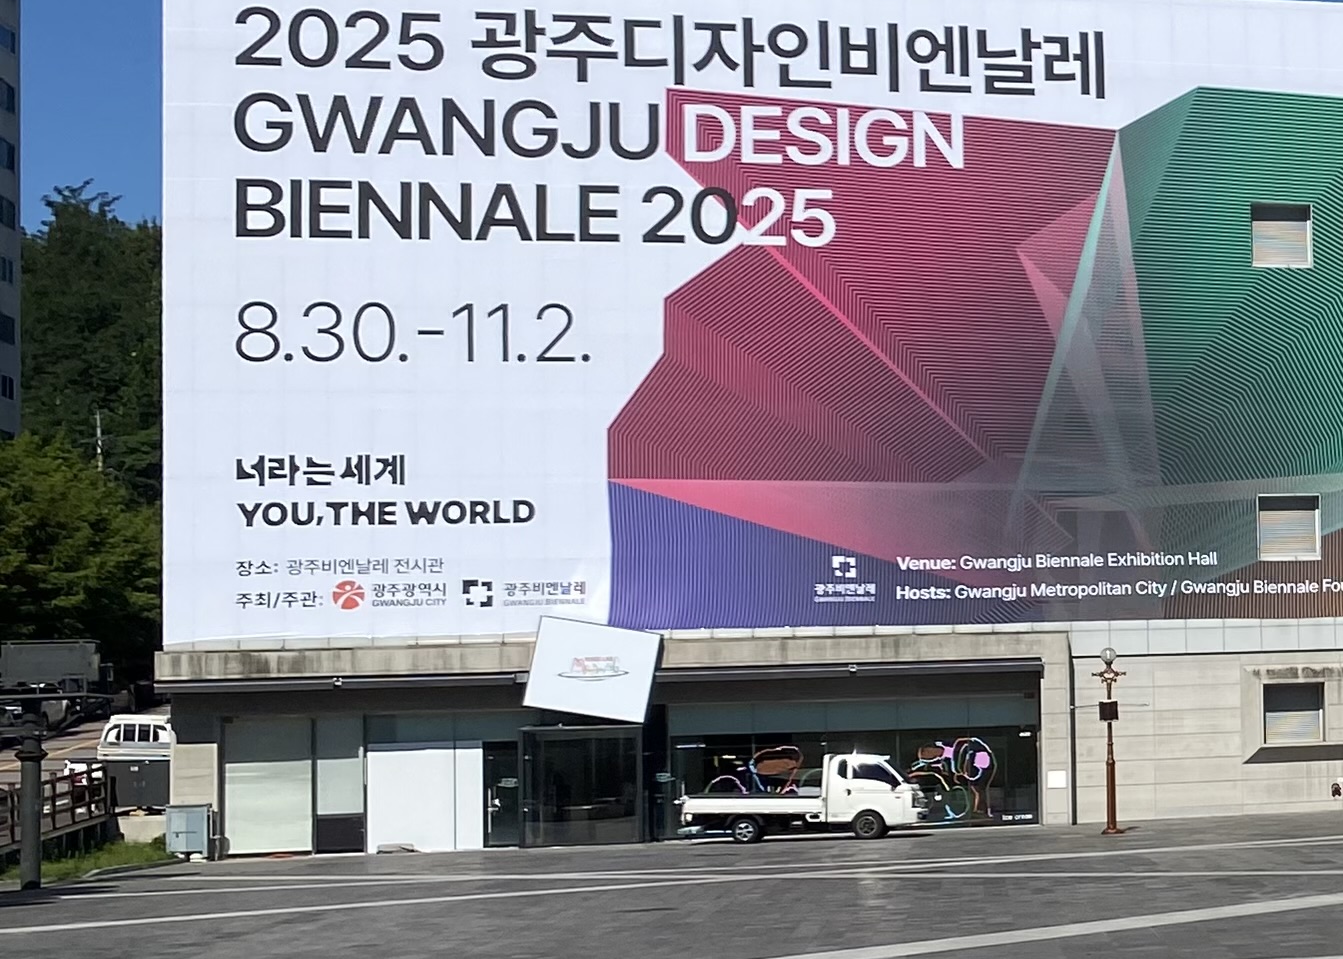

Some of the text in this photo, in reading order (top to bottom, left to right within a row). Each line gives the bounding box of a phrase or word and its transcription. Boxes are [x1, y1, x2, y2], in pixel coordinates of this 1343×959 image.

[235, 6, 1106, 100] 2025 광주디자인비엔날레
[233, 92, 965, 170] GWANGJU DESIGN
[235, 178, 837, 249] BIENNALE 2025
[404, 499, 536, 526] WORLD
[236, 557, 445, 577] 장소: 광주비엔날레 전시관
[896, 551, 1218, 572] Venue: Gwangju Biennale Exhibition Hall
[371, 582, 447, 598] 광주광역시
[503, 581, 586, 597] 광주비엔날레
[896, 585, 952, 600] Hosts:
[954, 583, 1027, 602] Gwangju
[1030, 581, 1132, 600] Metropolitan
[1135, 580, 1168, 598] City
[1180, 579, 1250, 597] Gwangju
[1253, 579, 1320, 594] Biennale
[235, 591, 324, 609] 주최/주관:
[371, 597, 447, 608] GWANGJU CITY
